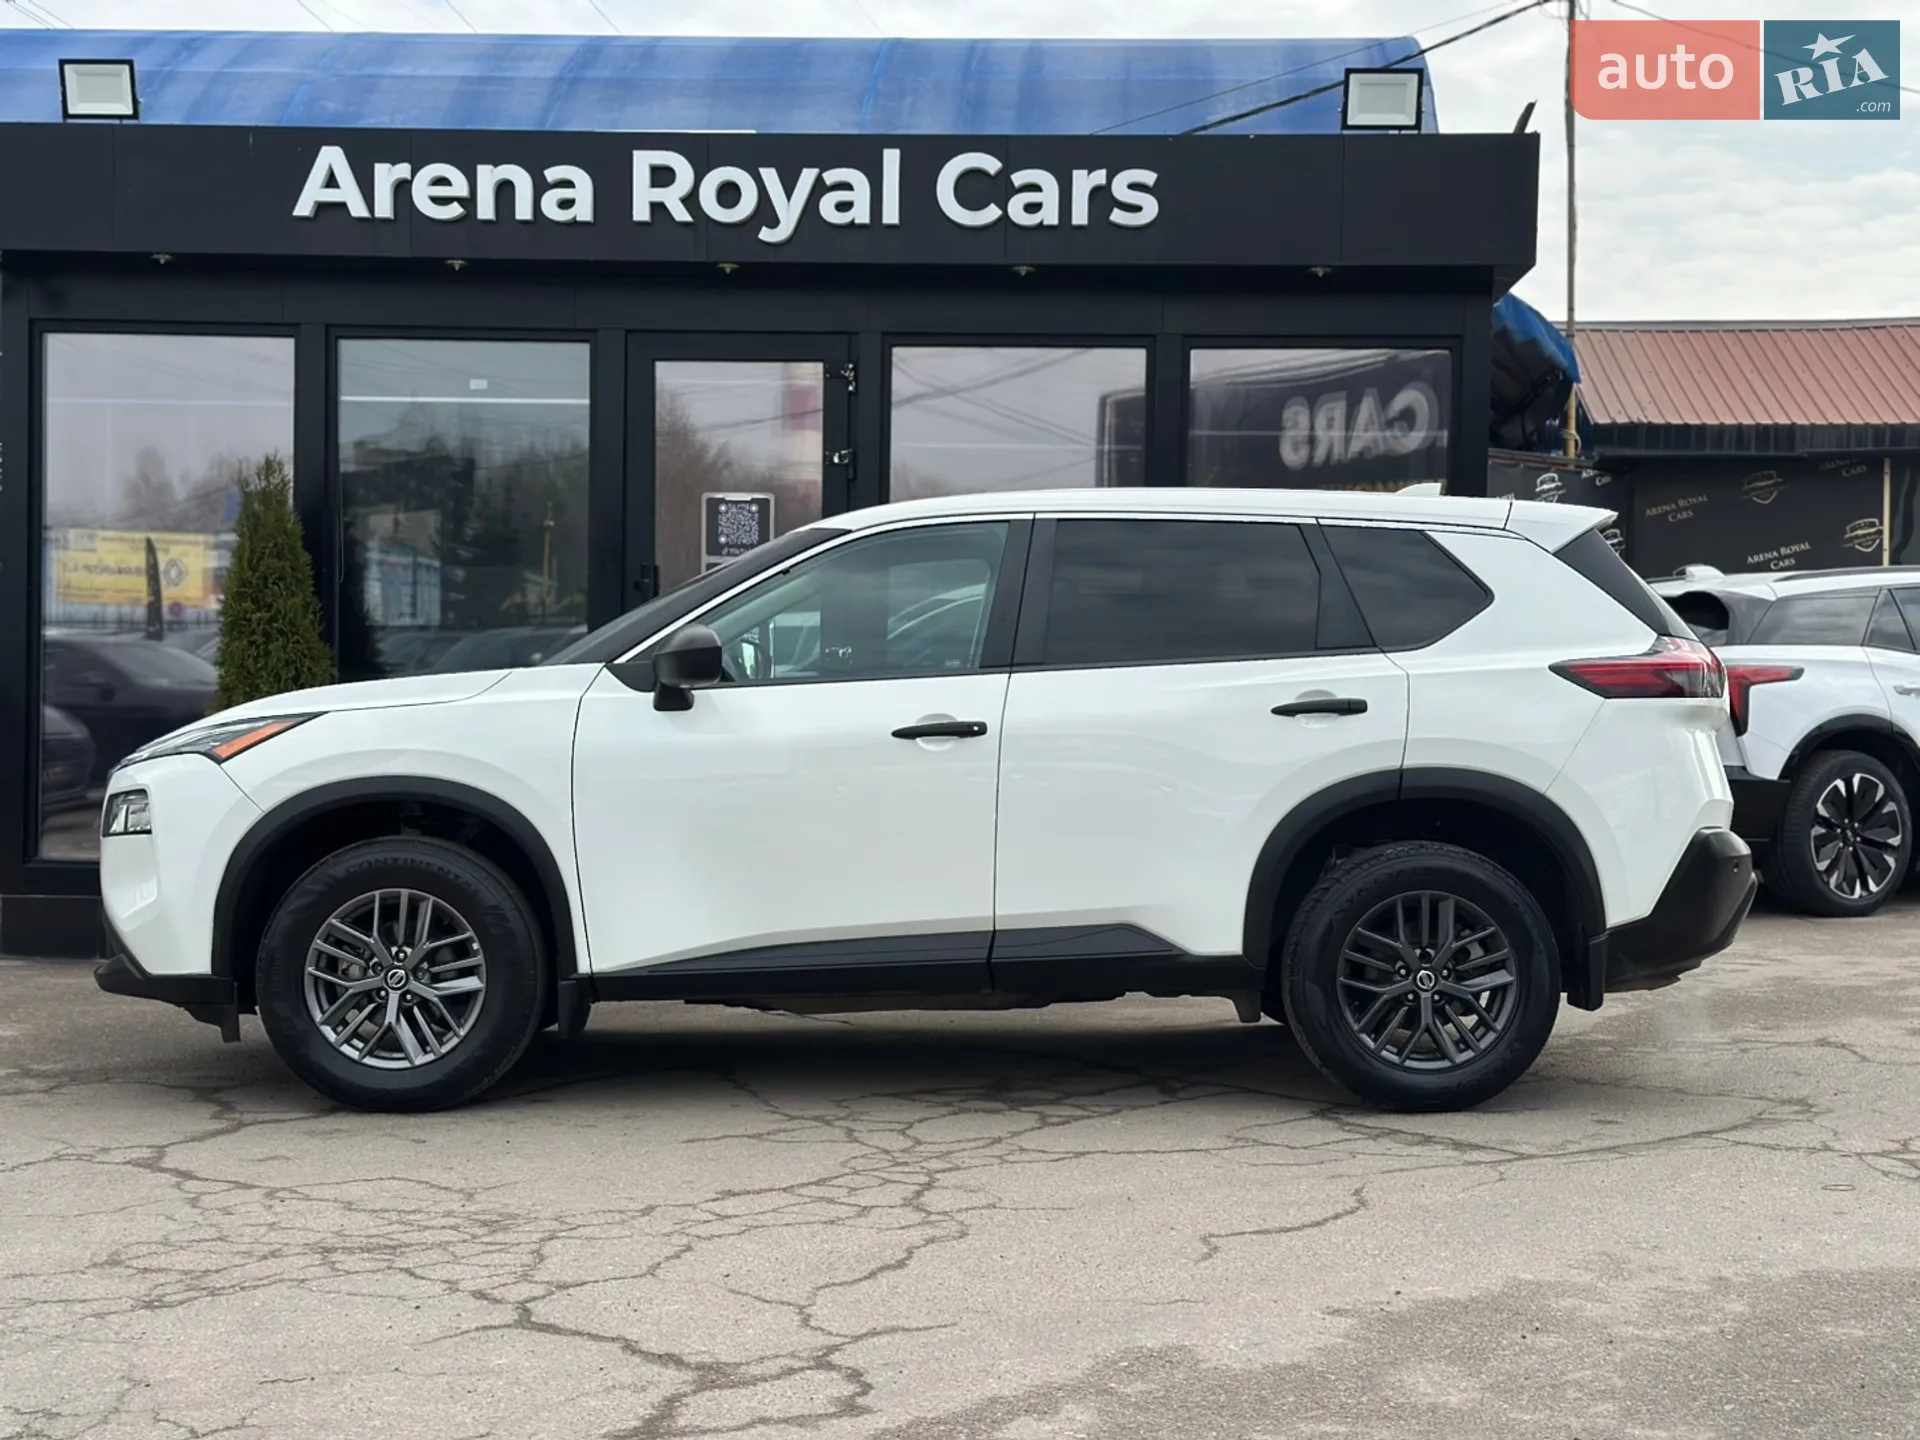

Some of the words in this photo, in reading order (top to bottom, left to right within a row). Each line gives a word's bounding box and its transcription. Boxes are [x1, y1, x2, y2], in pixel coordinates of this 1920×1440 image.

[292, 146, 595, 223] Arena
[631, 148, 901, 244] Royal
[936, 151, 1160, 228] Cars
[1645, 502, 1677, 517] ARENA
[1677, 493, 1709, 510] ROYAL
[1668, 509, 1694, 523] CARS
[1747, 549, 1780, 565] ARENA
[1780, 540, 1811, 557] ROYAL
[1770, 557, 1797, 571] CARS
